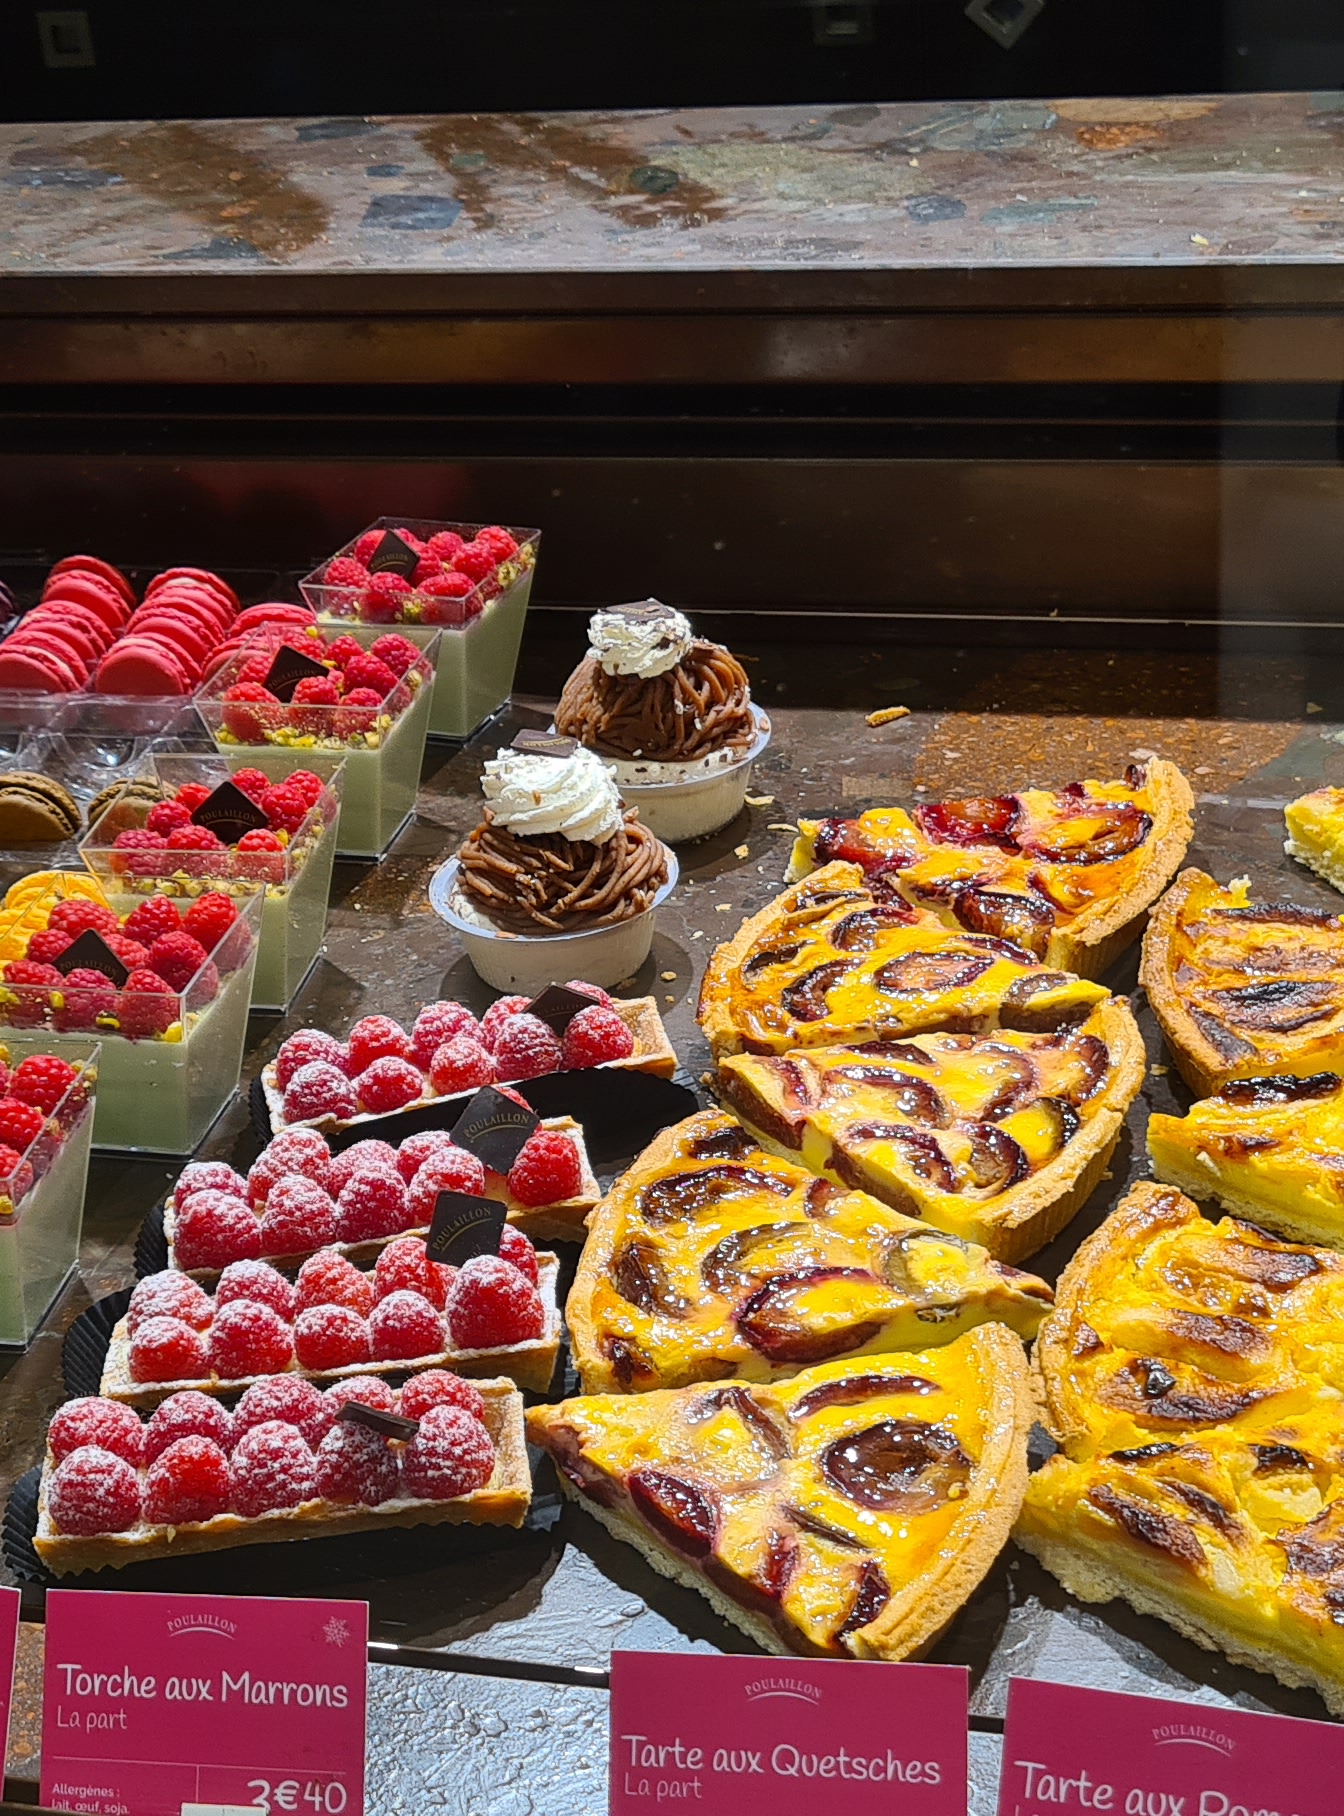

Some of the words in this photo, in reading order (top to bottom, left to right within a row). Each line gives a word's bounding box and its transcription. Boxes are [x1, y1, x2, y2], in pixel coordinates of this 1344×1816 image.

[462, 1112, 530, 1138] POULAILLON
[431, 1206, 492, 1252] POULAILLON
[166, 1613, 237, 1633] POULAILLON
[56, 1663, 157, 1699] Torche
[164, 1676, 214, 1702] aux
[221, 1670, 348, 1709] Marrons
[744, 1677, 822, 1700] POULAILLON
[56, 1705, 81, 1729] La
[86, 1707, 128, 1734] part
[1151, 1722, 1236, 1752] POULAILLON
[620, 1734, 704, 1771] Tarte
[712, 1747, 765, 1775] aux
[771, 1743, 942, 1786] Quetsches
[52, 1783, 115, 1799] Allergènes
[624, 1772, 651, 1797] La
[656, 1775, 703, 1803] part
[1013, 1759, 1114, 1810] Tarte
[1124, 1787, 1187, 1816] aux
